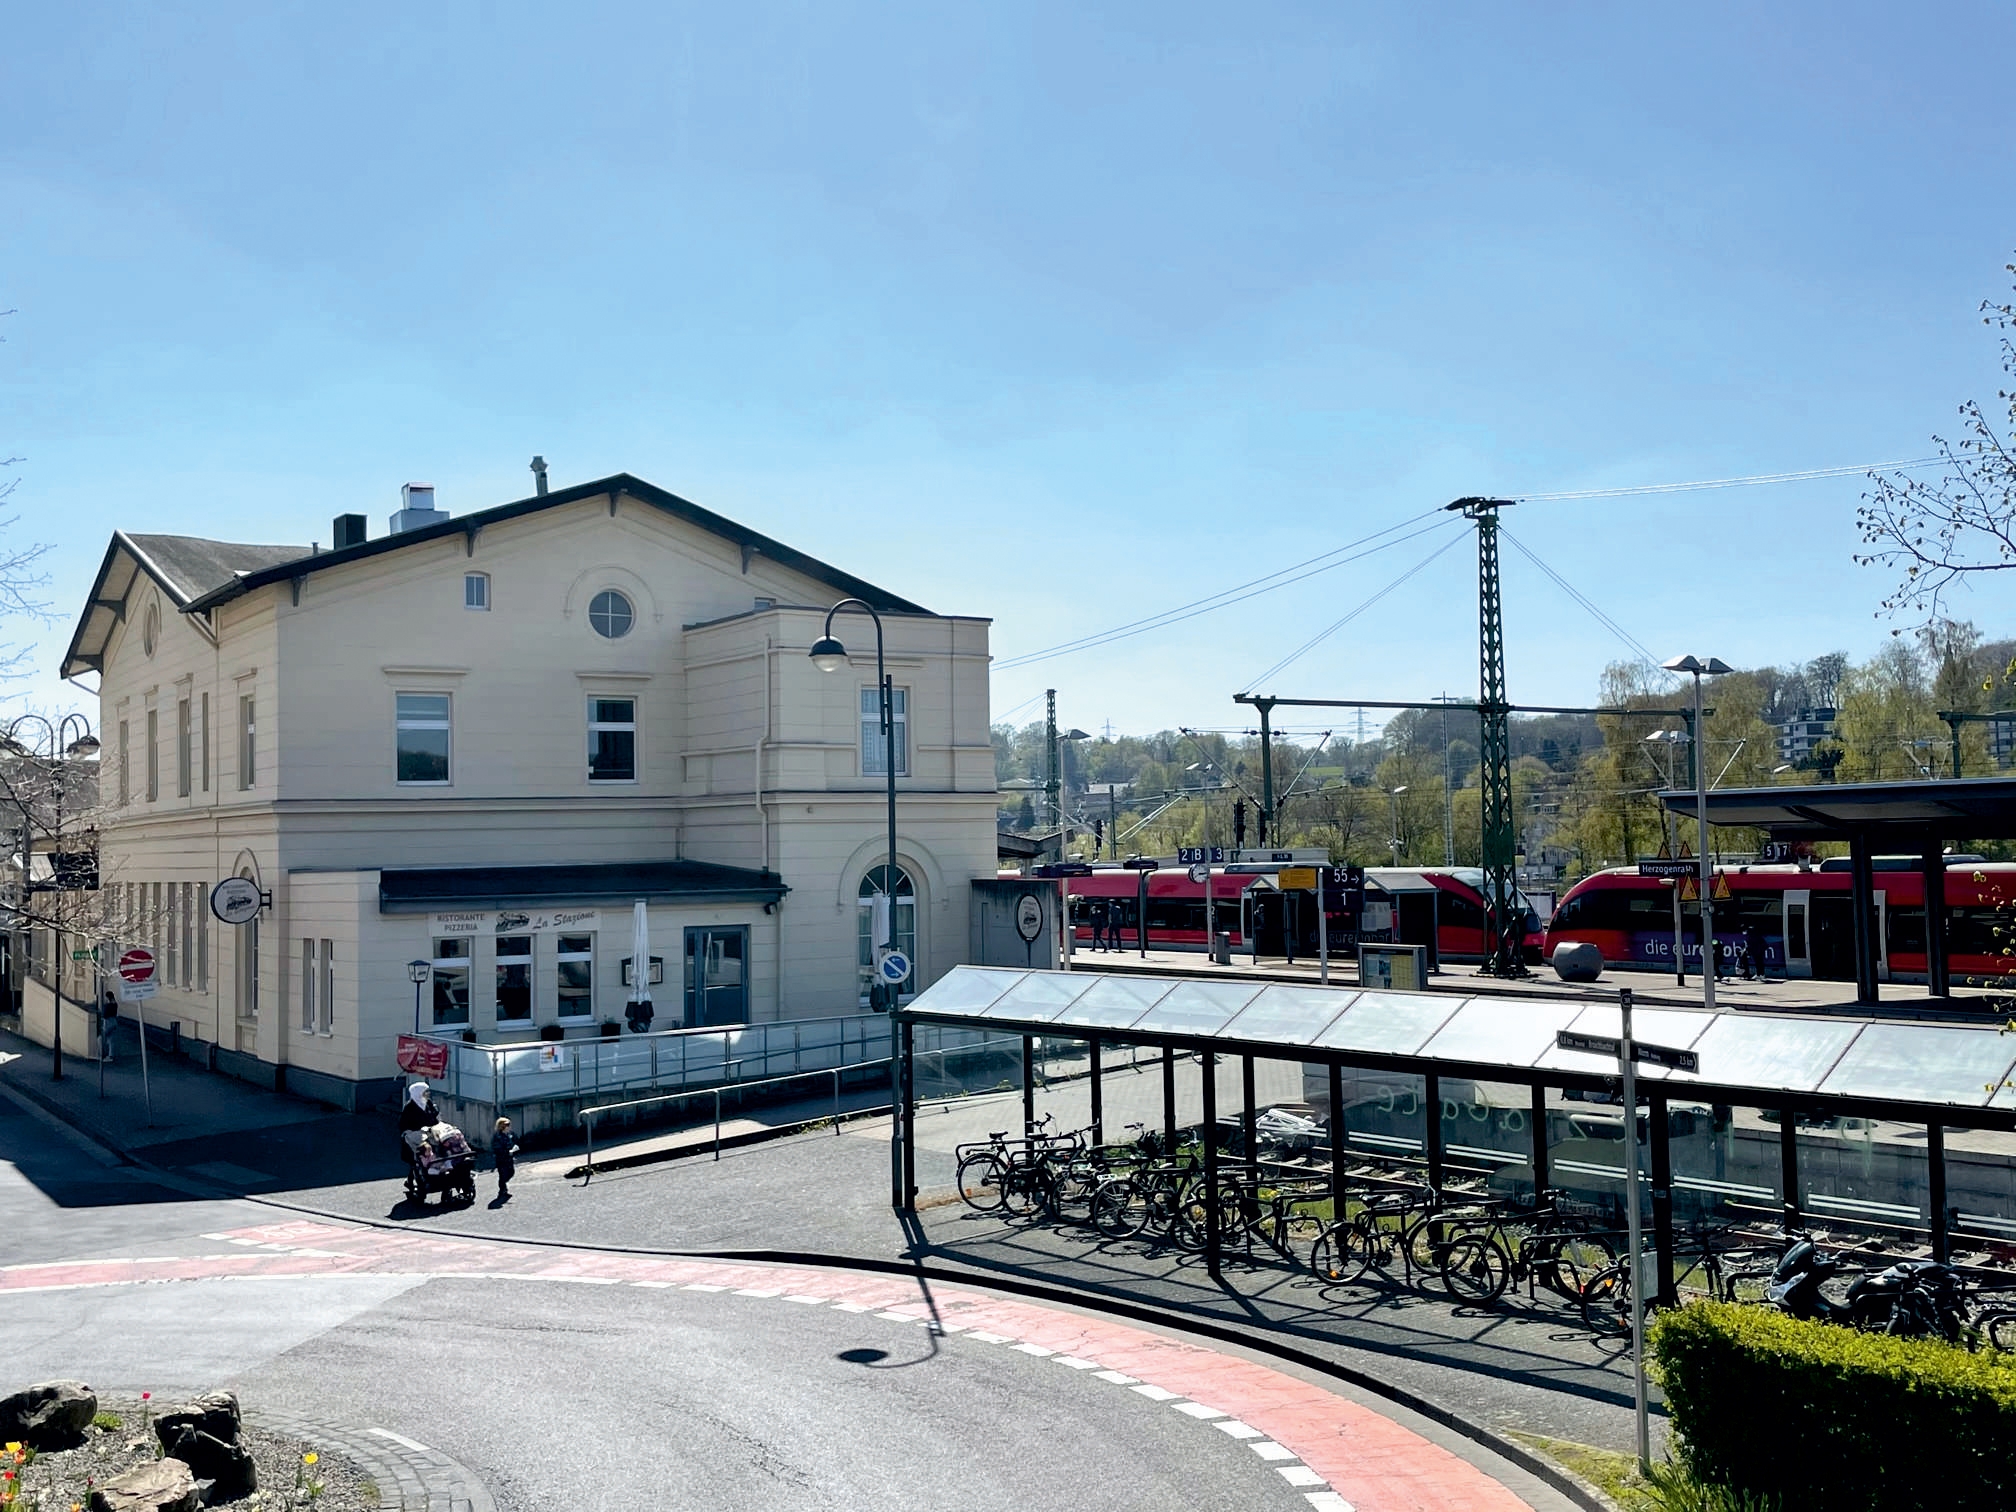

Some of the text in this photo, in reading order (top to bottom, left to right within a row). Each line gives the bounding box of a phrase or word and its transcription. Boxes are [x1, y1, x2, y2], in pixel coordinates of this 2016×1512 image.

[1181, 848, 1202, 861] 2 B
[1216, 847, 1223, 860] 3
[1333, 868, 1348, 883] 55
[1642, 864, 1694, 875] Herzogenrath
[1341, 892, 1347, 906] 1
[437, 912, 486, 922] RISTORANTE
[532, 911, 595, 930] La Stazione
[444, 923, 478, 932] PIZZERIA
[1645, 939, 1668, 955] die
